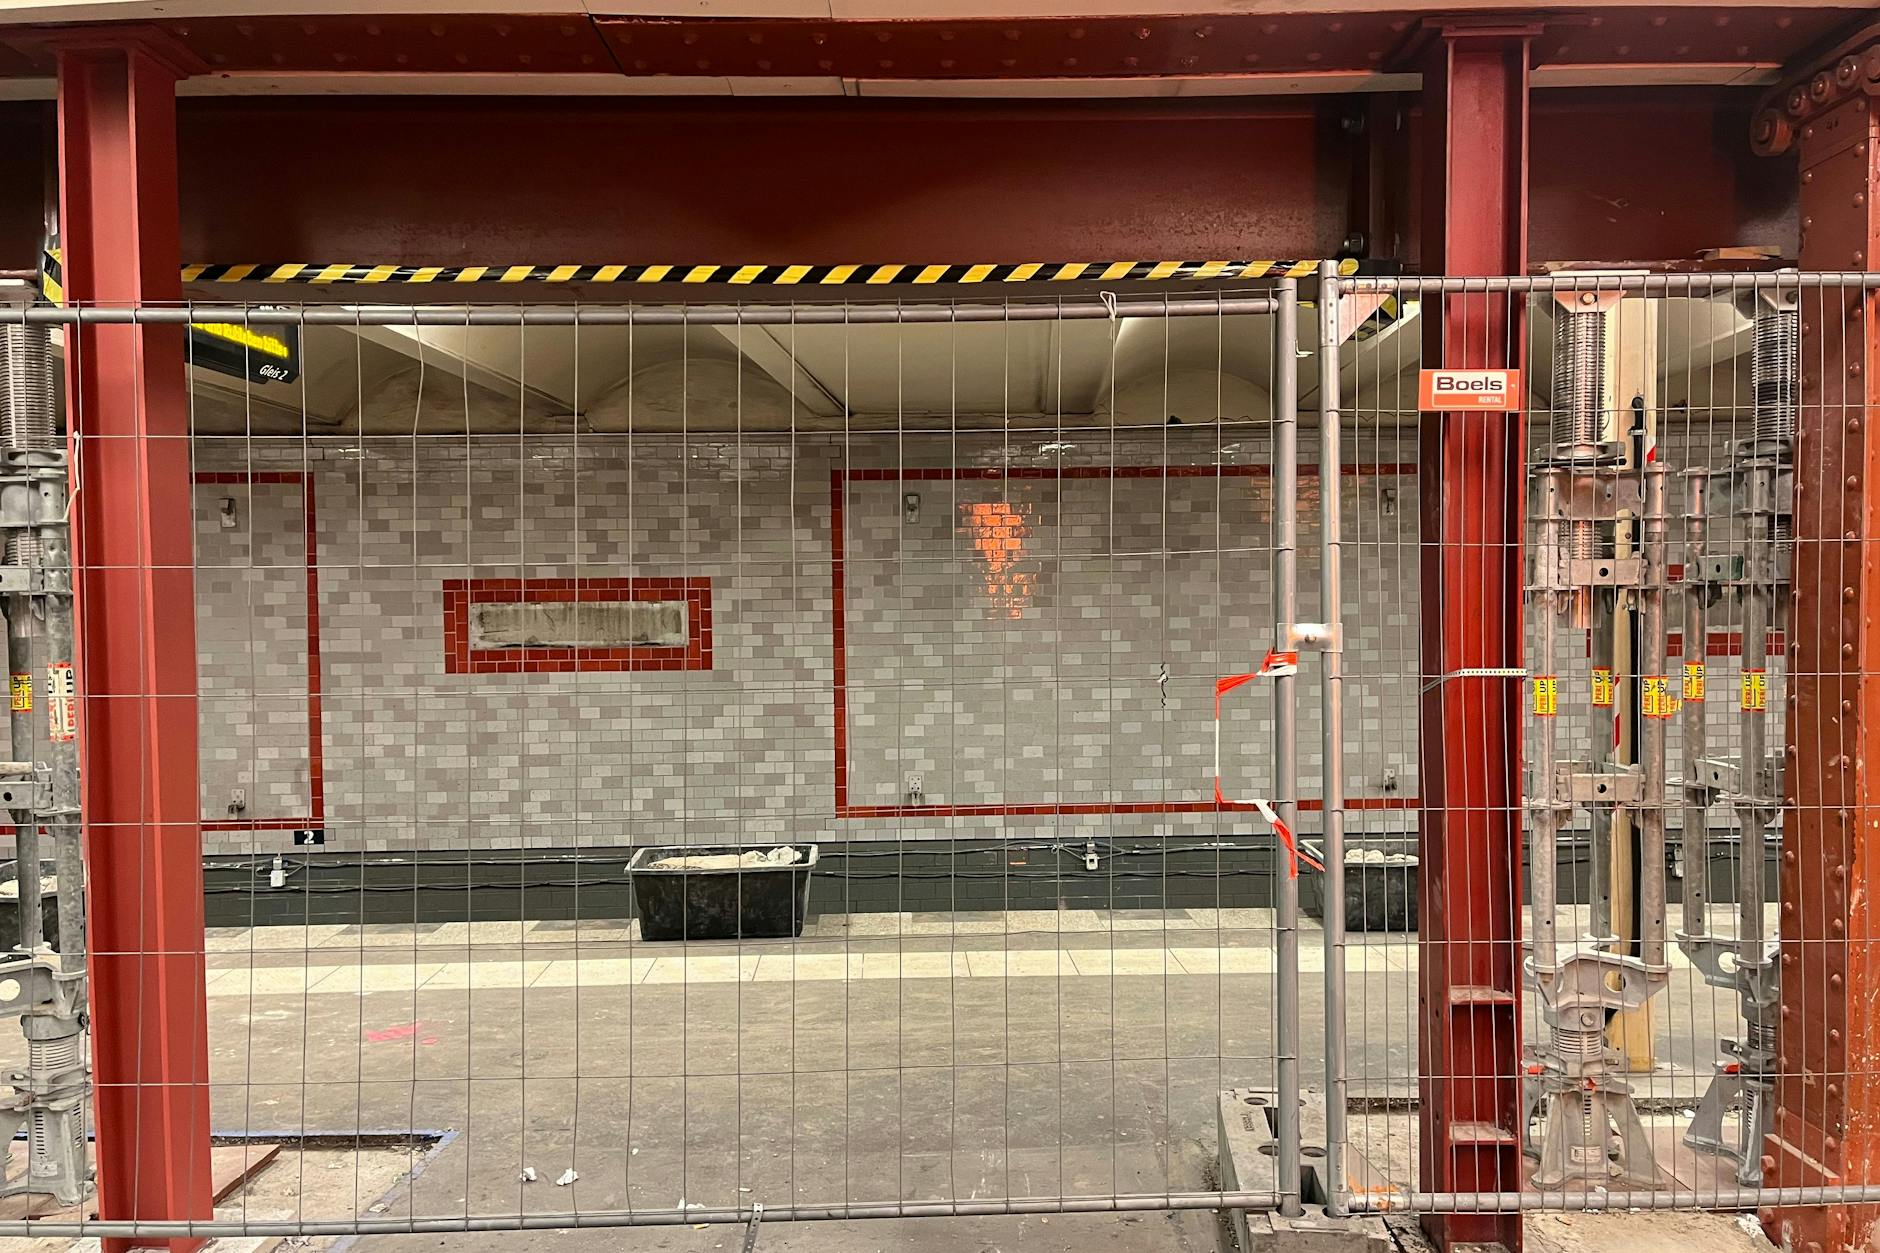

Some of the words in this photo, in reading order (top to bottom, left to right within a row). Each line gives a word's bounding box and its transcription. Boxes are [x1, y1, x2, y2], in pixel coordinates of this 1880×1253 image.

[259, 365, 281, 379] Gleis
[278, 370, 288, 381] 2
[1436, 376, 1503, 391] Boels
[1478, 395, 1502, 404] RENTAL
[1684, 665, 1690, 678] UP
[1696, 666, 1703, 680] UP
[13, 676, 21, 689] UP
[1540, 681, 1546, 692] UP
[1643, 679, 1650, 693] UP
[1658, 679, 1665, 693] UP
[1745, 674, 1751, 687] UP
[1759, 674, 1766, 687] UP
[303, 830, 315, 844] 2
